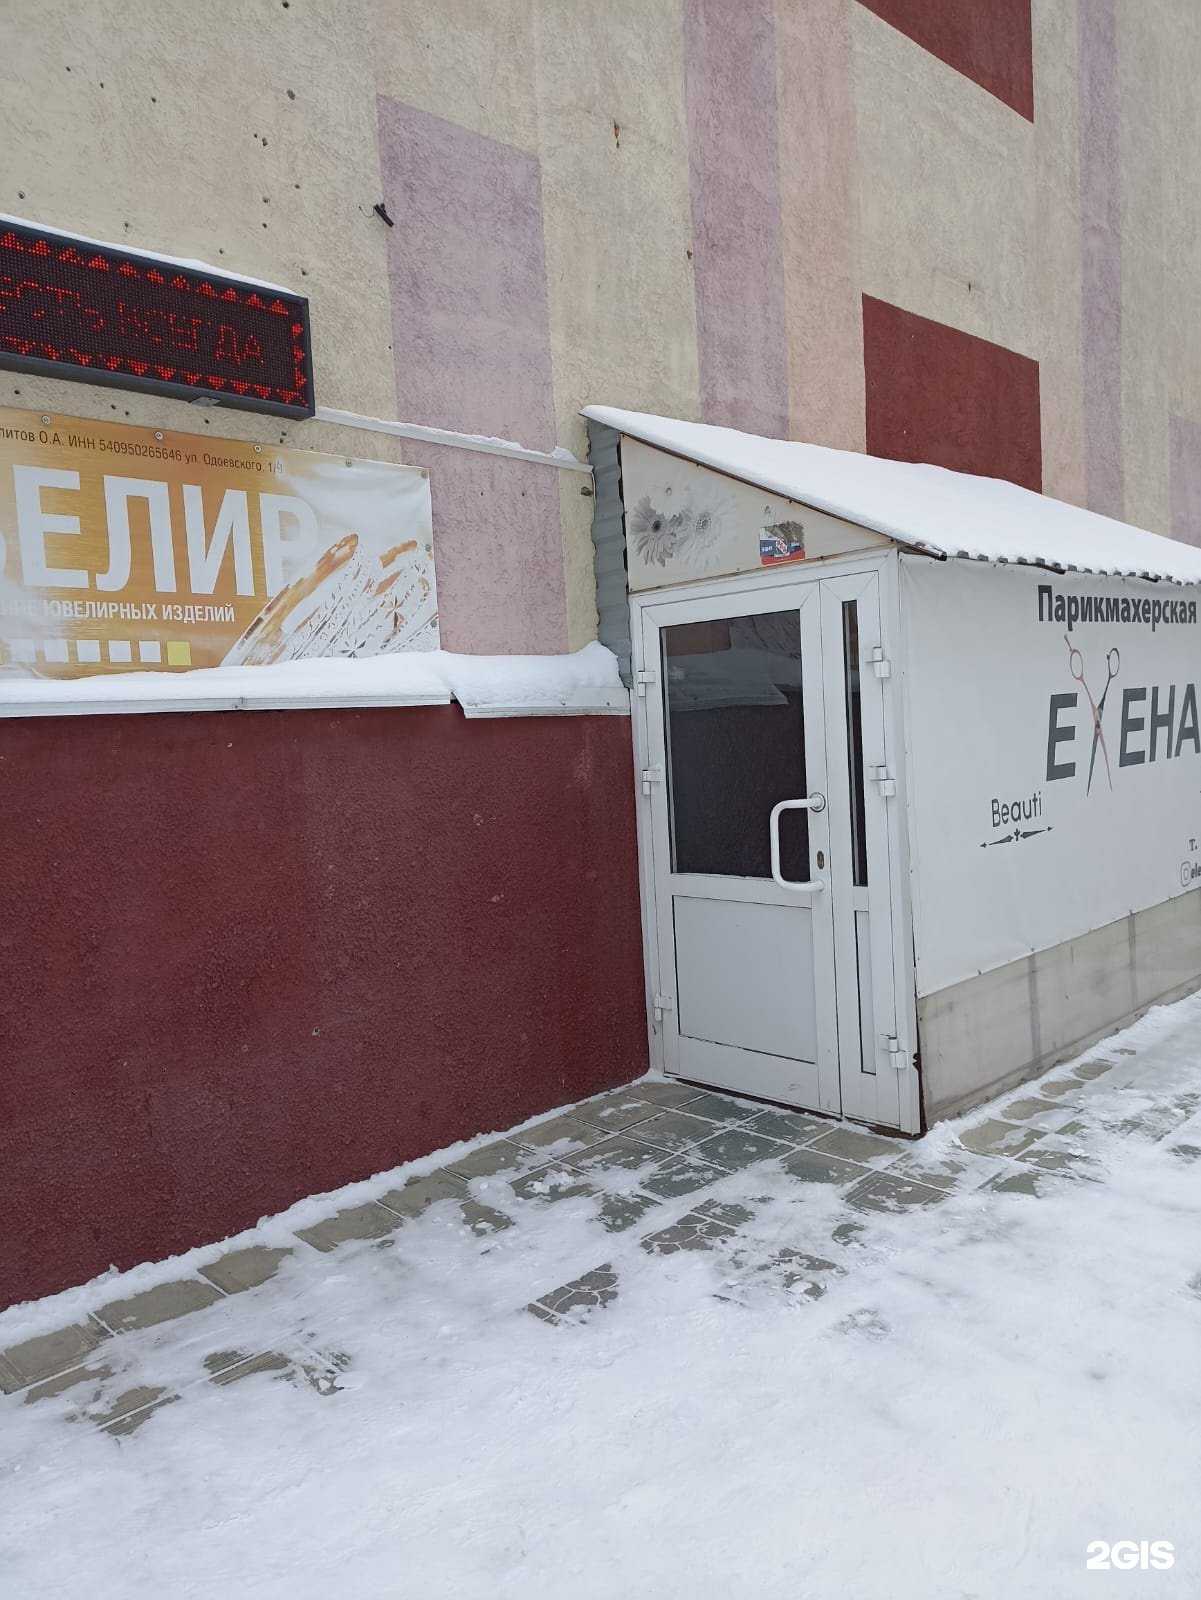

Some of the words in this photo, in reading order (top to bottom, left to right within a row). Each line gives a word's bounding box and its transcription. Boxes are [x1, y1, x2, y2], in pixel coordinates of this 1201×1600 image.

[39, 430, 64, 445] О.А.
[68, 434, 96, 449] ИНН
[0, 463, 318, 600] ЕЛИР
[162, 603, 236, 624] ИЗДЕЛИЙ
[1037, 584, 1197, 632] Парикмахерская
[991, 791, 1043, 828] Beauti
